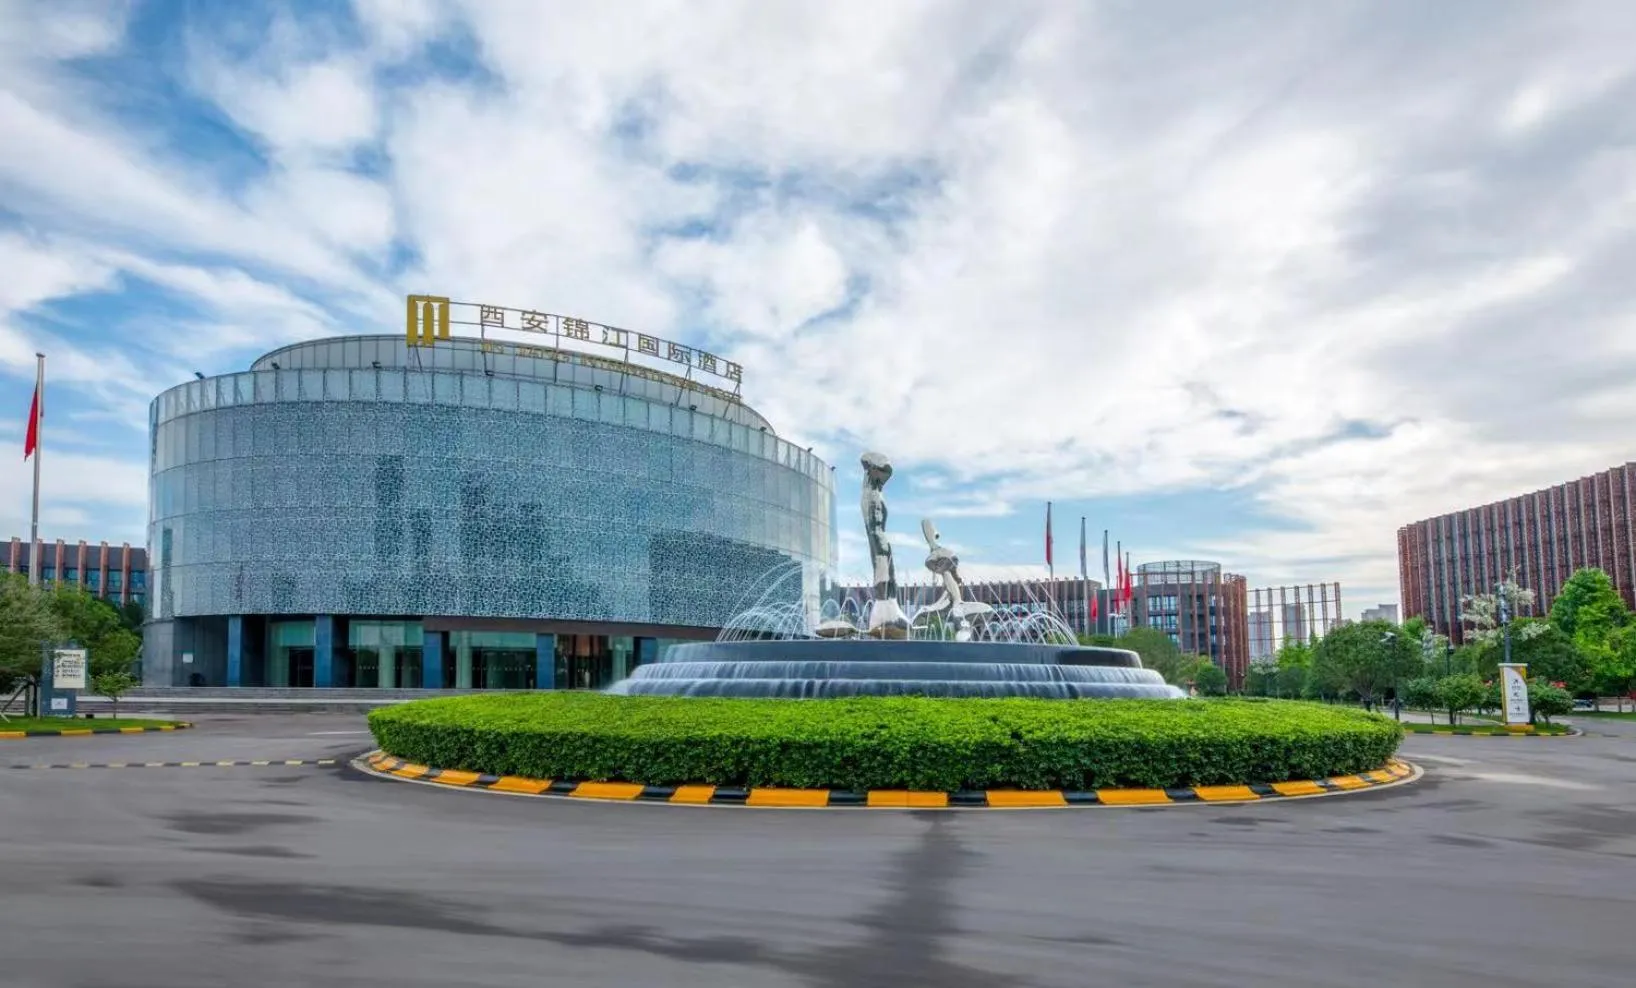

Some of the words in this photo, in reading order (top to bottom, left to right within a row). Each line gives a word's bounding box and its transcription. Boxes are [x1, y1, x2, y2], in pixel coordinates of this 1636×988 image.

[480, 304, 743, 382] 西安锦江国际酒店
